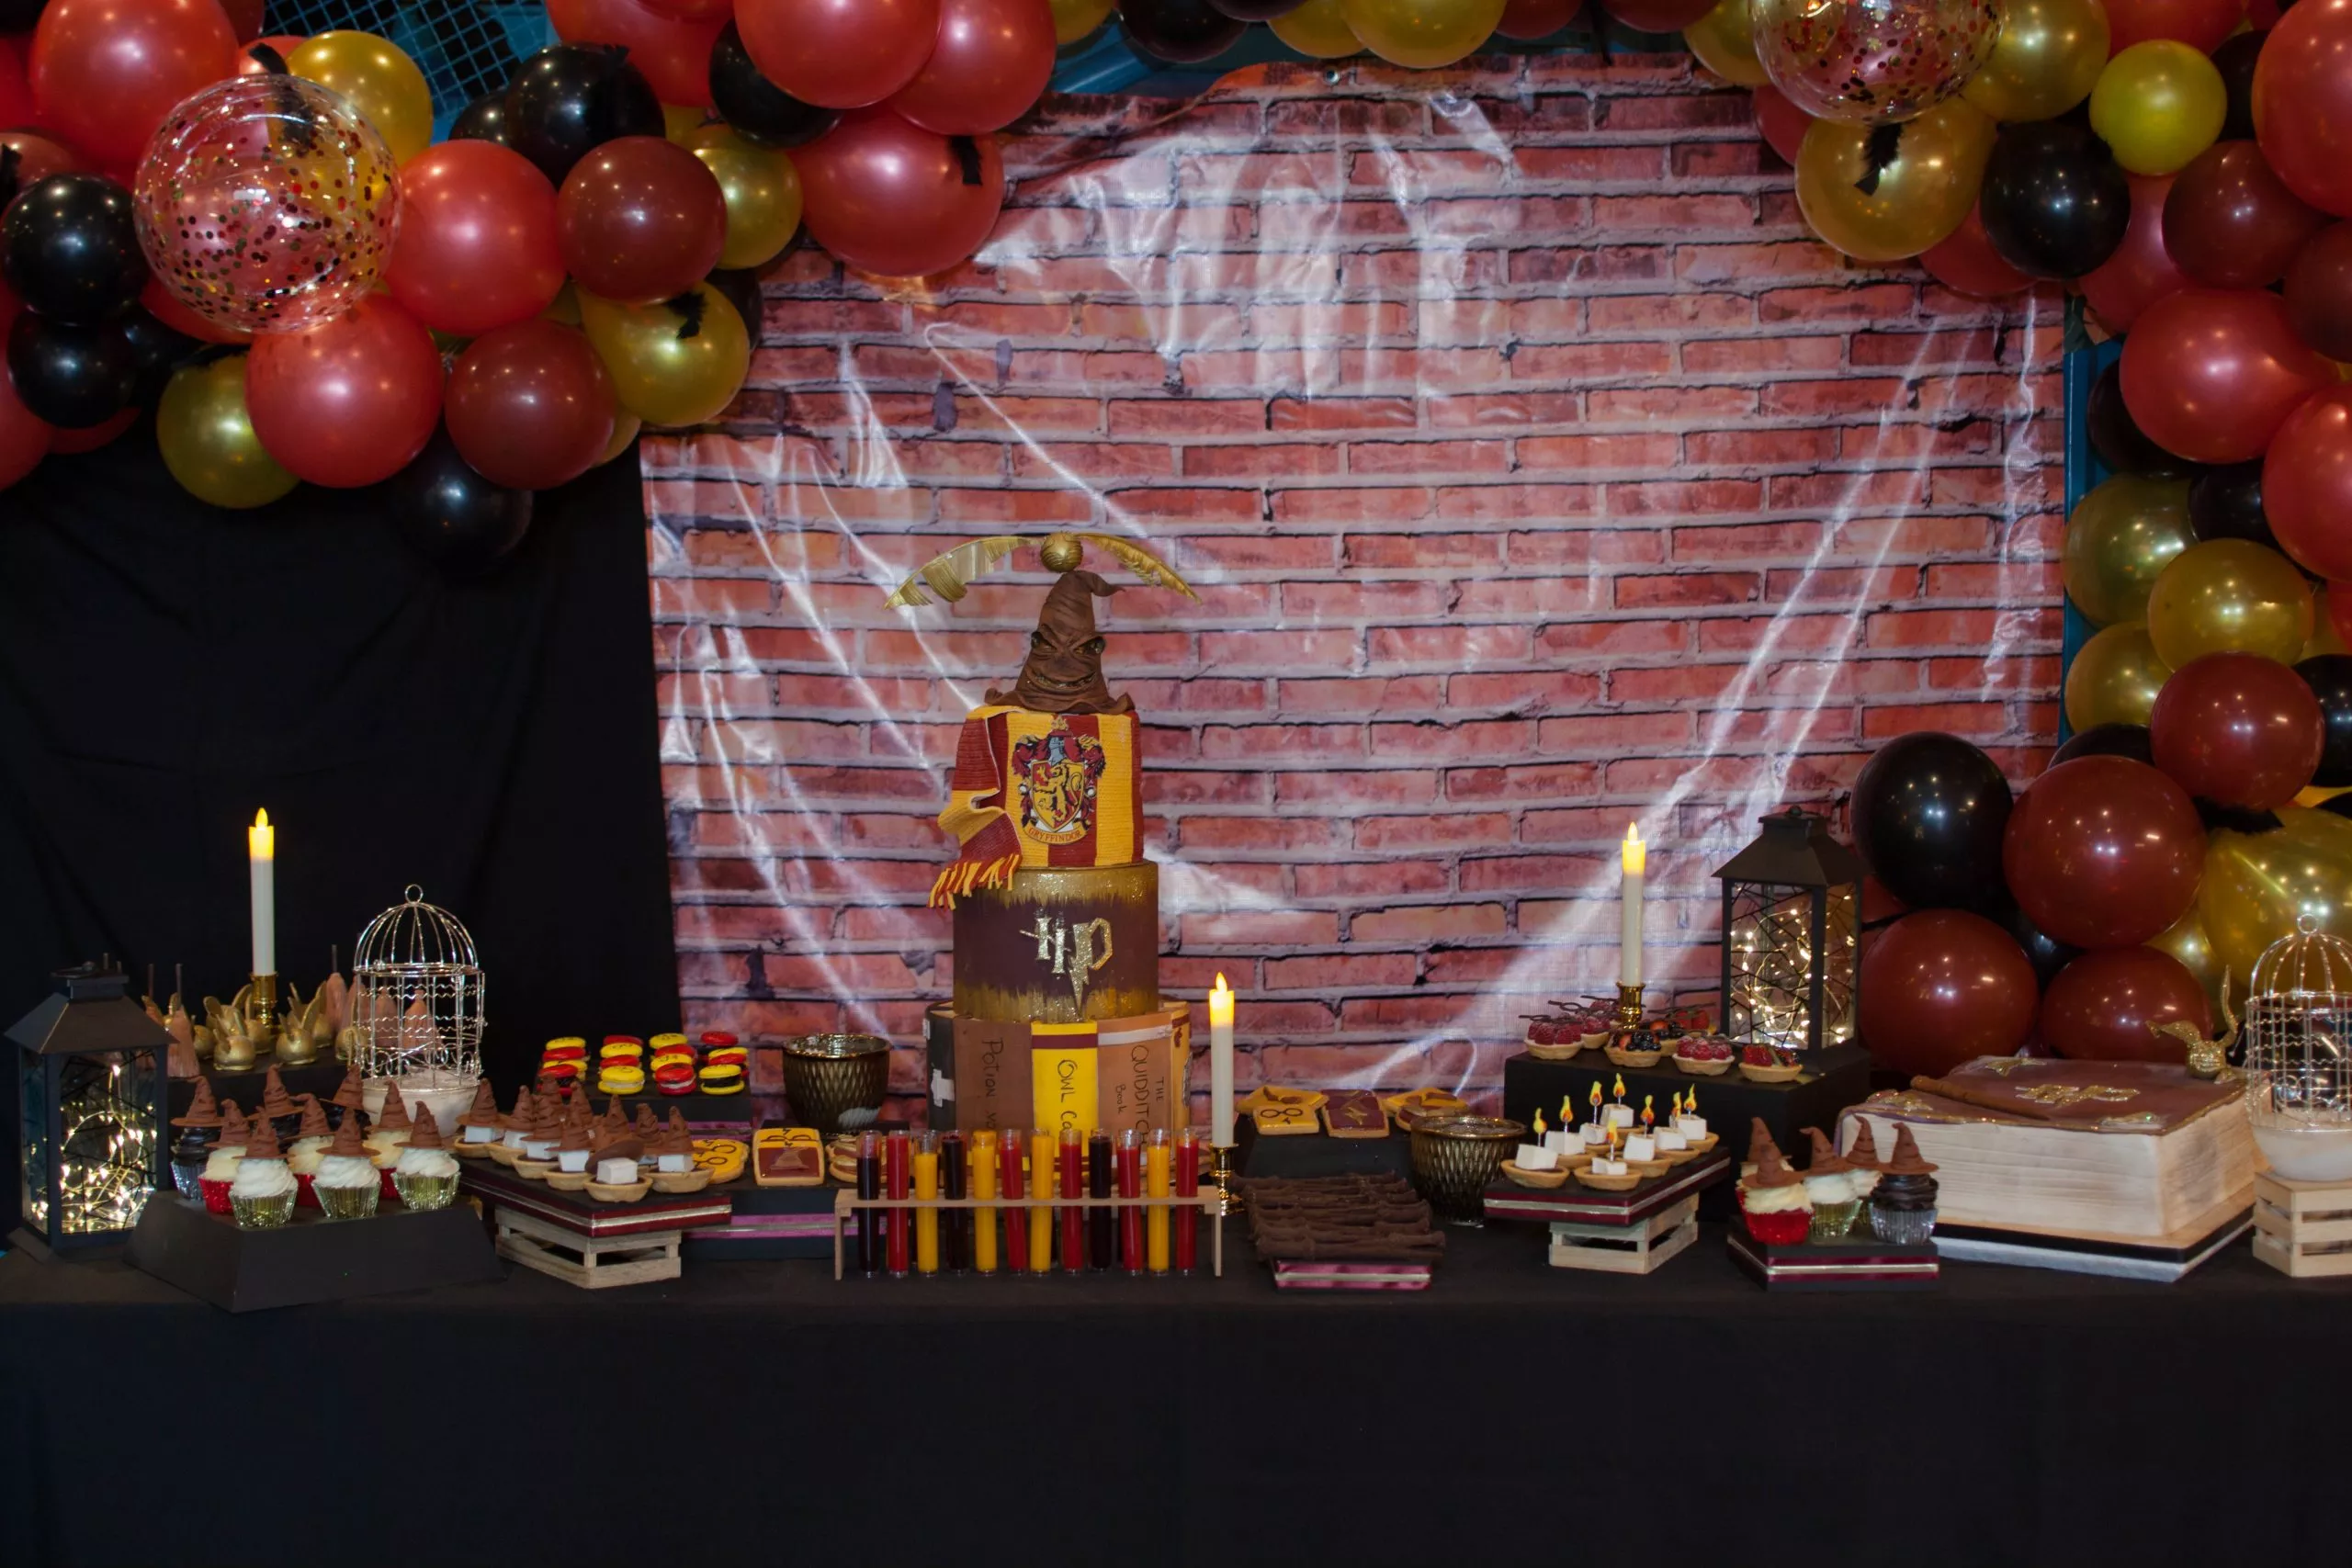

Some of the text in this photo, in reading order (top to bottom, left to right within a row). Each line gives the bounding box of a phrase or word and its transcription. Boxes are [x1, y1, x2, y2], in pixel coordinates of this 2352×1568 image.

[1028, 827, 1081, 842] GRYFFINDOR
[1019, 917, 1114, 1014] HP
[1057, 1059, 1079, 1103] OWL
[1156, 1076, 1165, 1102] THE
